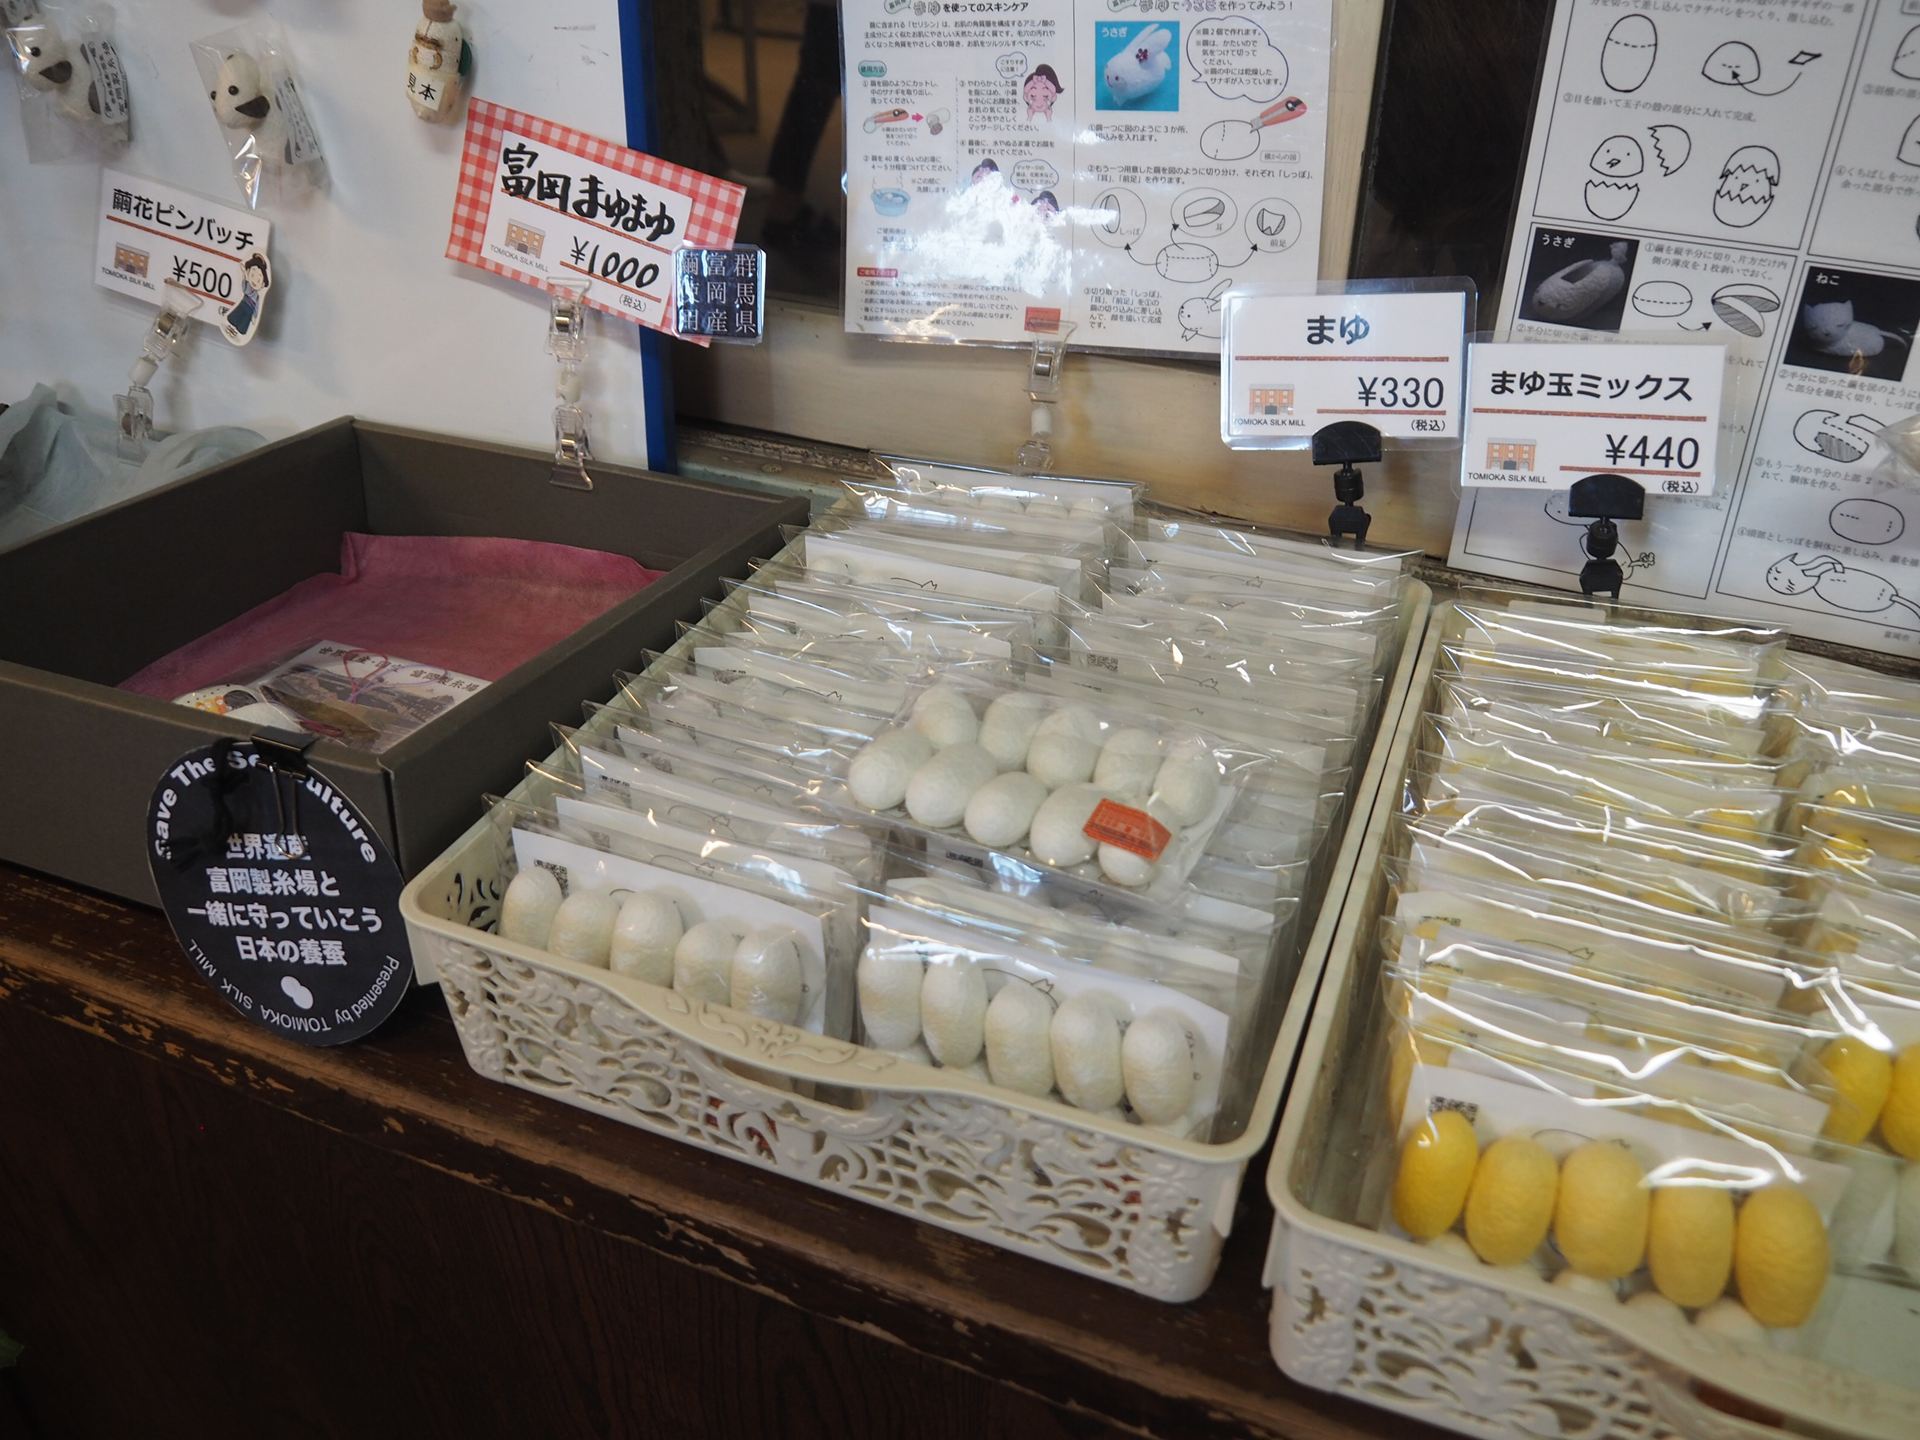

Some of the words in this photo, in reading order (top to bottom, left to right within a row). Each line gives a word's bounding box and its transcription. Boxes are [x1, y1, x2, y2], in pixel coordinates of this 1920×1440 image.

[1101, 27, 1128, 38] うさぎ
[408, 72, 437, 101] 見本
[501, 142, 676, 242] 富岡まゆまゆ
[112, 188, 254, 250] 繭花ピンバッチ
[1541, 233, 1575, 249] うさぎ
[172, 255, 232, 298] ¥500
[570, 236, 660, 289] ¥1000
[707, 252, 728, 333] 富岡産
[733, 252, 756, 334] 群馬県
[1815, 272, 1841, 286] ねこ
[1306, 314, 1370, 346] まゆ
[1357, 376, 1445, 409] ¥330
[1490, 370, 1693, 402] まゆ玉ミックス
[1269, 418, 1287, 427] SILK
[1288, 419, 1306, 428] MILL
[1605, 433, 1700, 470] ¥440
[1467, 471, 1506, 482] TOMIOKA
[1508, 473, 1526, 483] SILK
[1528, 475, 1547, 484] MILL
[170, 755, 217, 787] The
[205, 866, 341, 898] 富岡製糸場と
[187, 900, 383, 934] 一緒に守っていこう
[186, 938, 218, 978] MILL
[235, 935, 348, 967] 日本の養蚕
[220, 976, 254, 1010] SILK
[351, 954, 400, 1017] Presented
[260, 1005, 332, 1033] TOMIOKA
[335, 1007, 353, 1025] by
